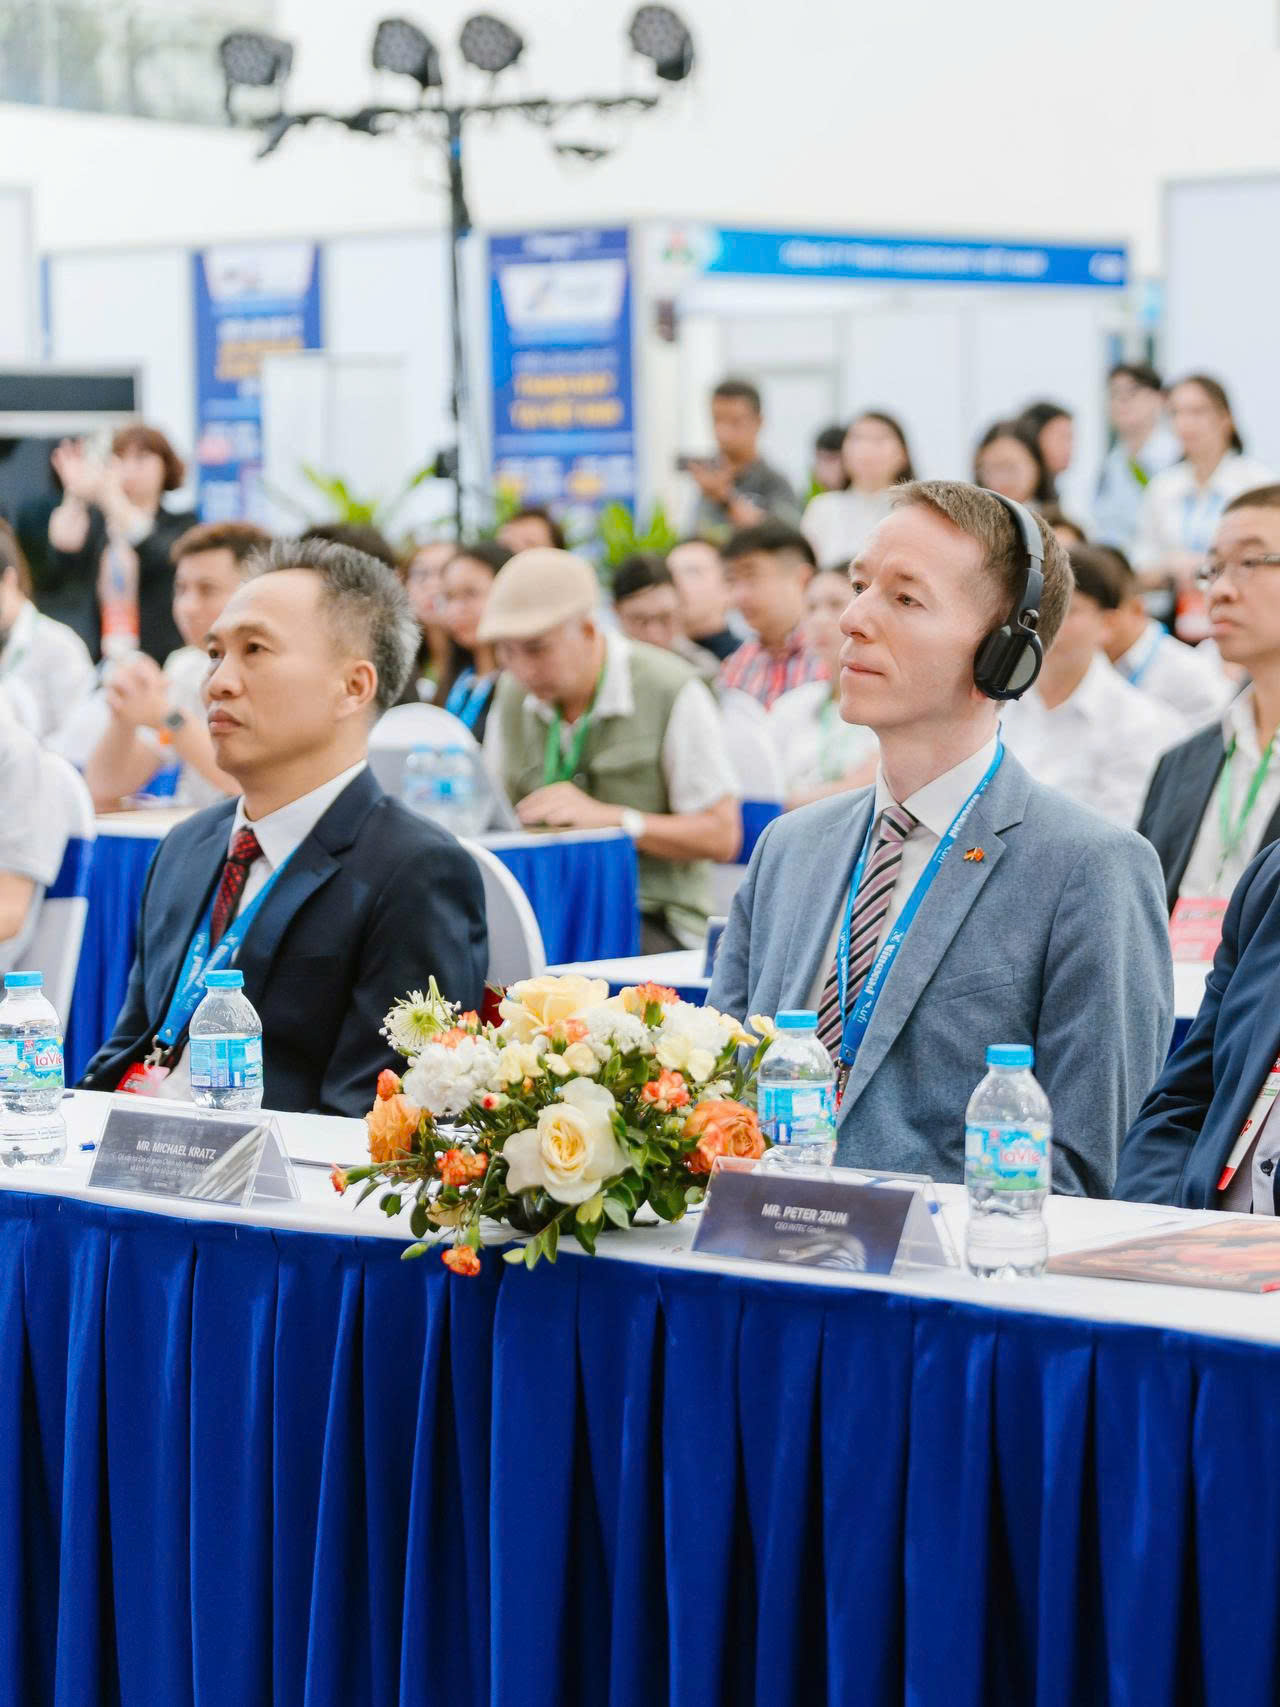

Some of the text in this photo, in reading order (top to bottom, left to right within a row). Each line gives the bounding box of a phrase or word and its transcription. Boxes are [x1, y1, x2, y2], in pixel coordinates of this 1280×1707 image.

[136, 1140, 217, 1160] MR. MICHAEL KRATZ
[761, 1203, 848, 1225] MR. PETER ZDUN
